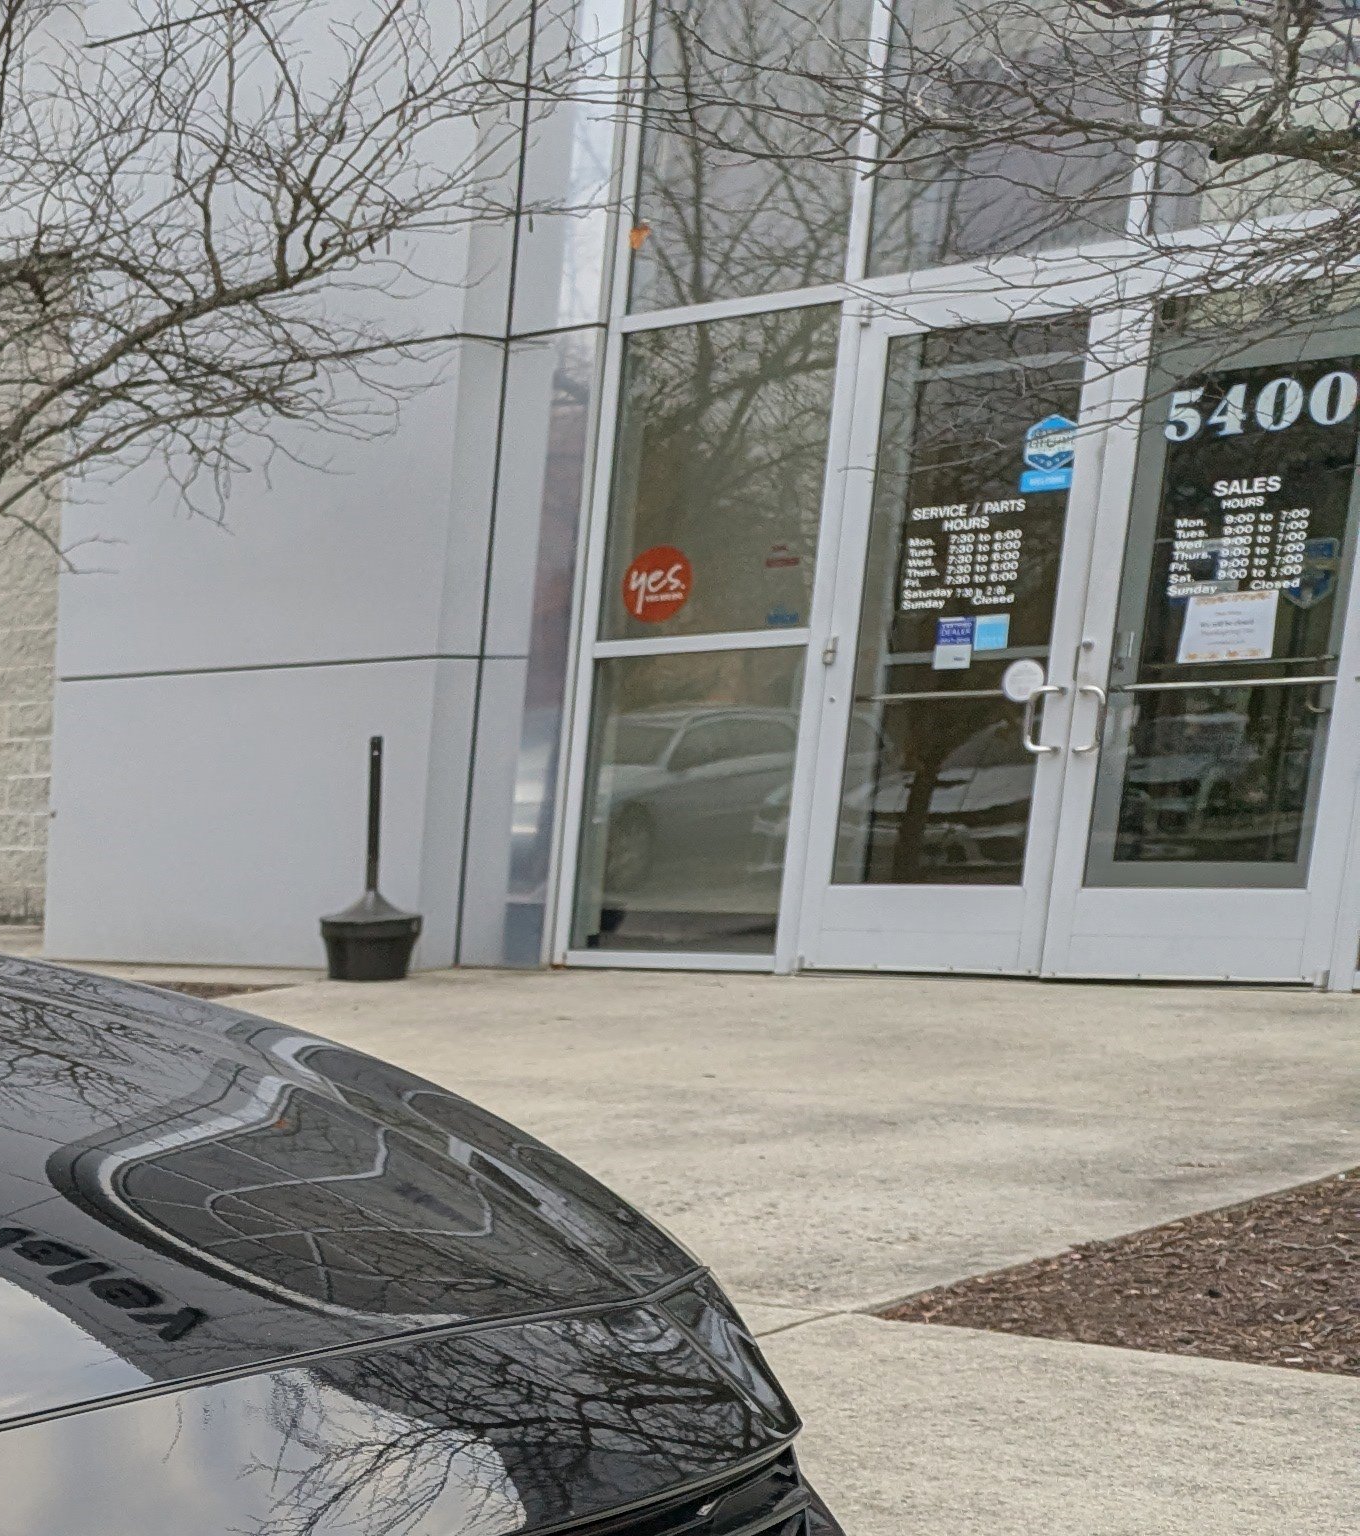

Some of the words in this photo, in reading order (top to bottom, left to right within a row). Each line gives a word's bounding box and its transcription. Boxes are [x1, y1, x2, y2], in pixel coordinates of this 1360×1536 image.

[1164, 371, 1358, 442] 5400
[1213, 476, 1281, 496] SALES
[1220, 496, 1264, 509] HOURS
[912, 504, 968, 520] SERVICE
[983, 499, 1026, 514] PARTS
[1260, 513, 1273, 521] to
[942, 516, 989, 531] HOURS
[1258, 524, 1272, 532] to
[1256, 536, 1270, 544] to
[1255, 547, 1269, 555] to
[1254, 558, 1267, 566] to
[1251, 569, 1266, 577] to
[1167, 585, 1217, 597] Sunday
[1250, 578, 1300, 590] Closed
[903, 589, 953, 600] Saturday
[902, 600, 945, 610] Sunday
[972, 593, 1014, 605] Closed
